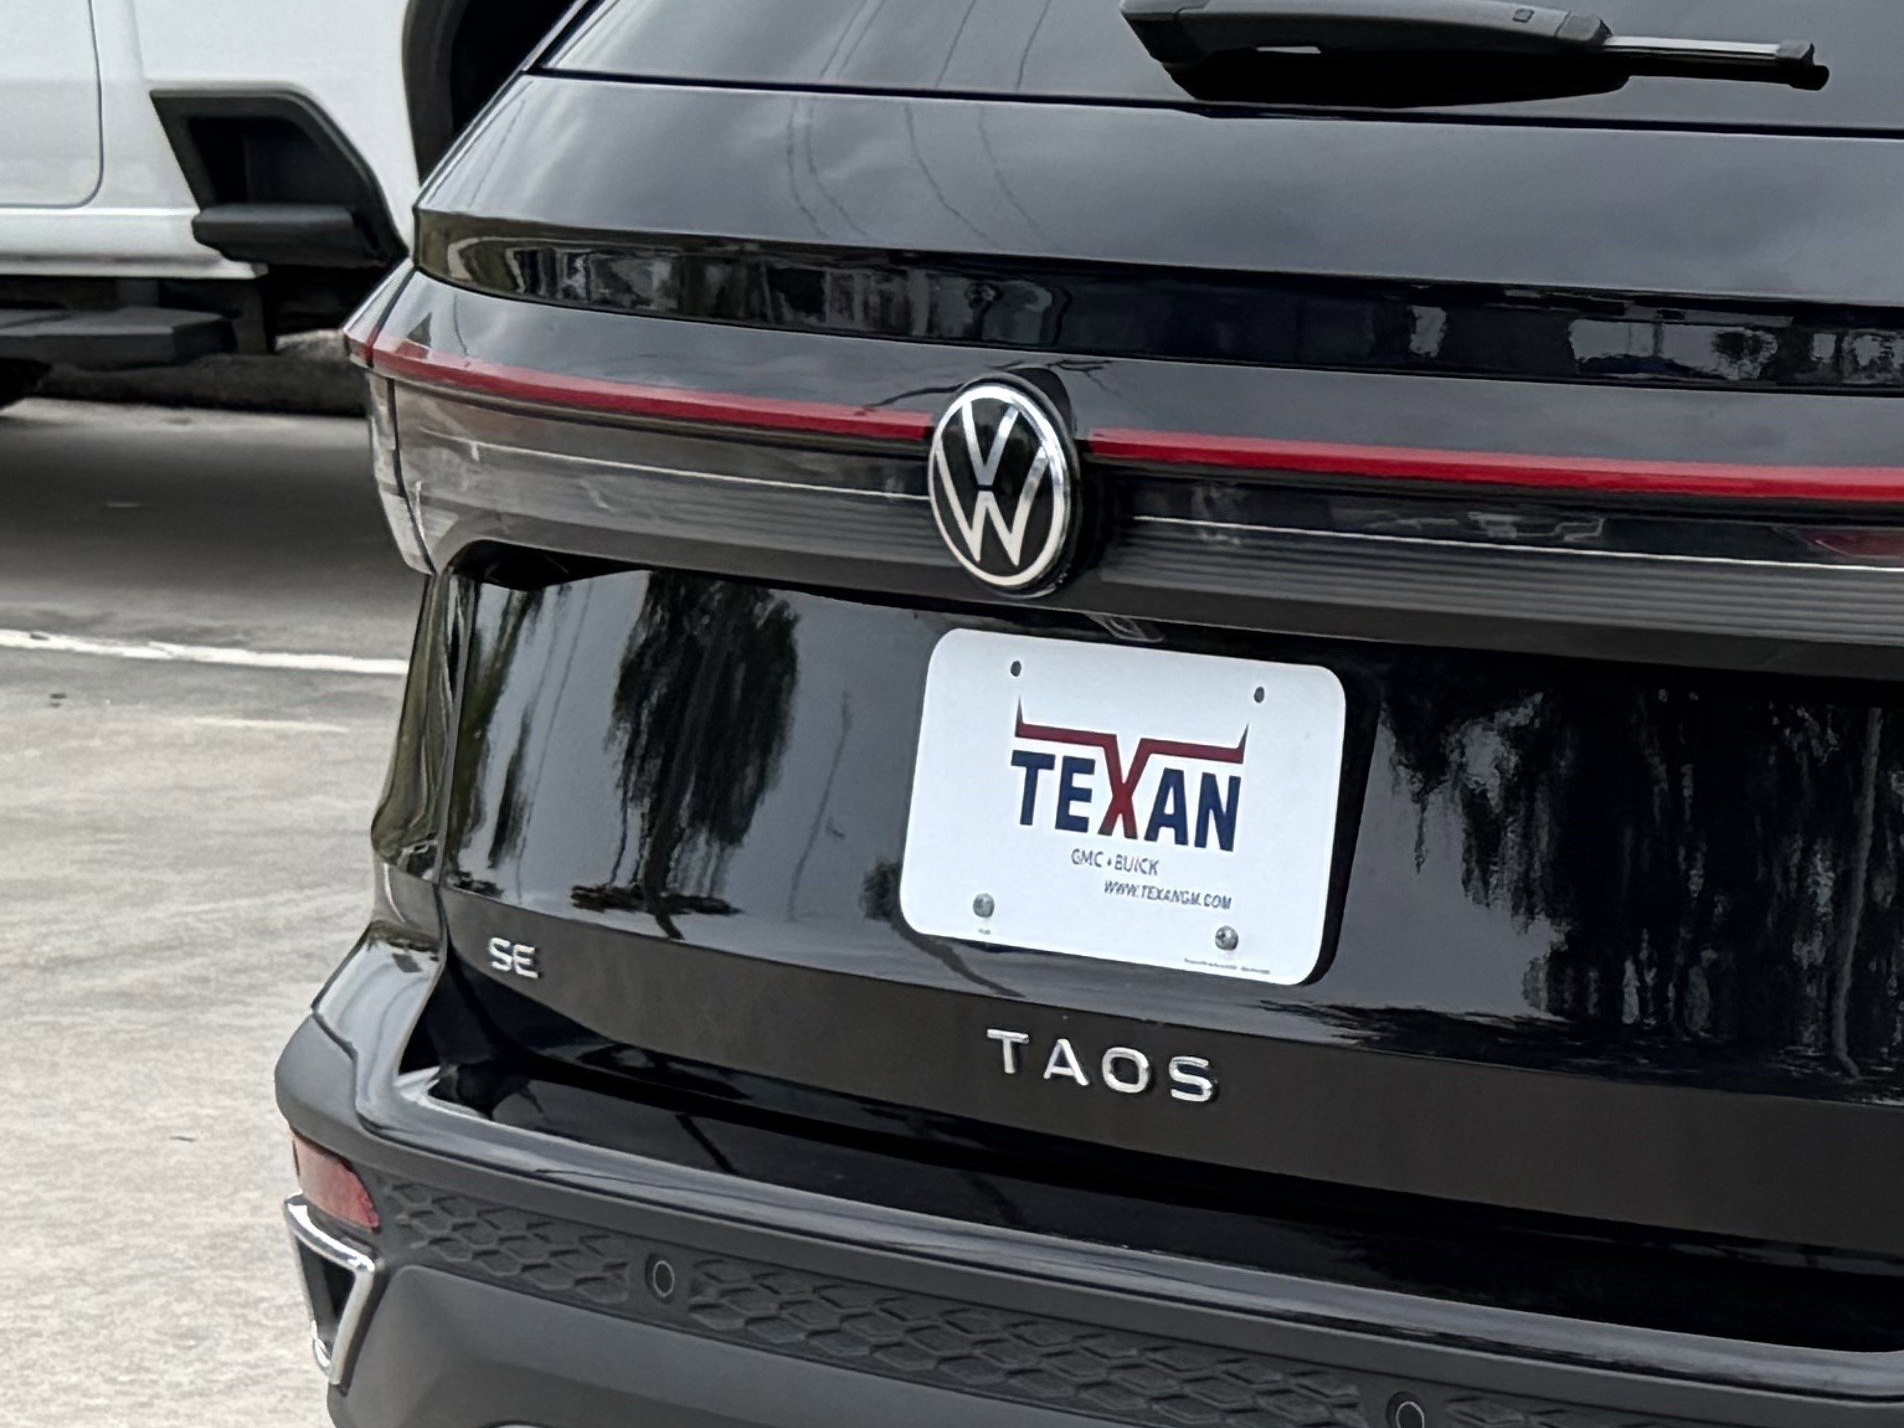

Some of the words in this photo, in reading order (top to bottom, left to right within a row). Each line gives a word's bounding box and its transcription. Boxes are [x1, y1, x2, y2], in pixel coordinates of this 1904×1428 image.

[1010, 720, 1249, 853] TEXAN
[1070, 848, 1105, 868] GMC
[1113, 854, 1160, 876] BUICK
[1103, 879, 1233, 910] WWW.TEXANGM.COM
[488, 936, 540, 980] SE
[985, 1028, 1219, 1104] TAOS
